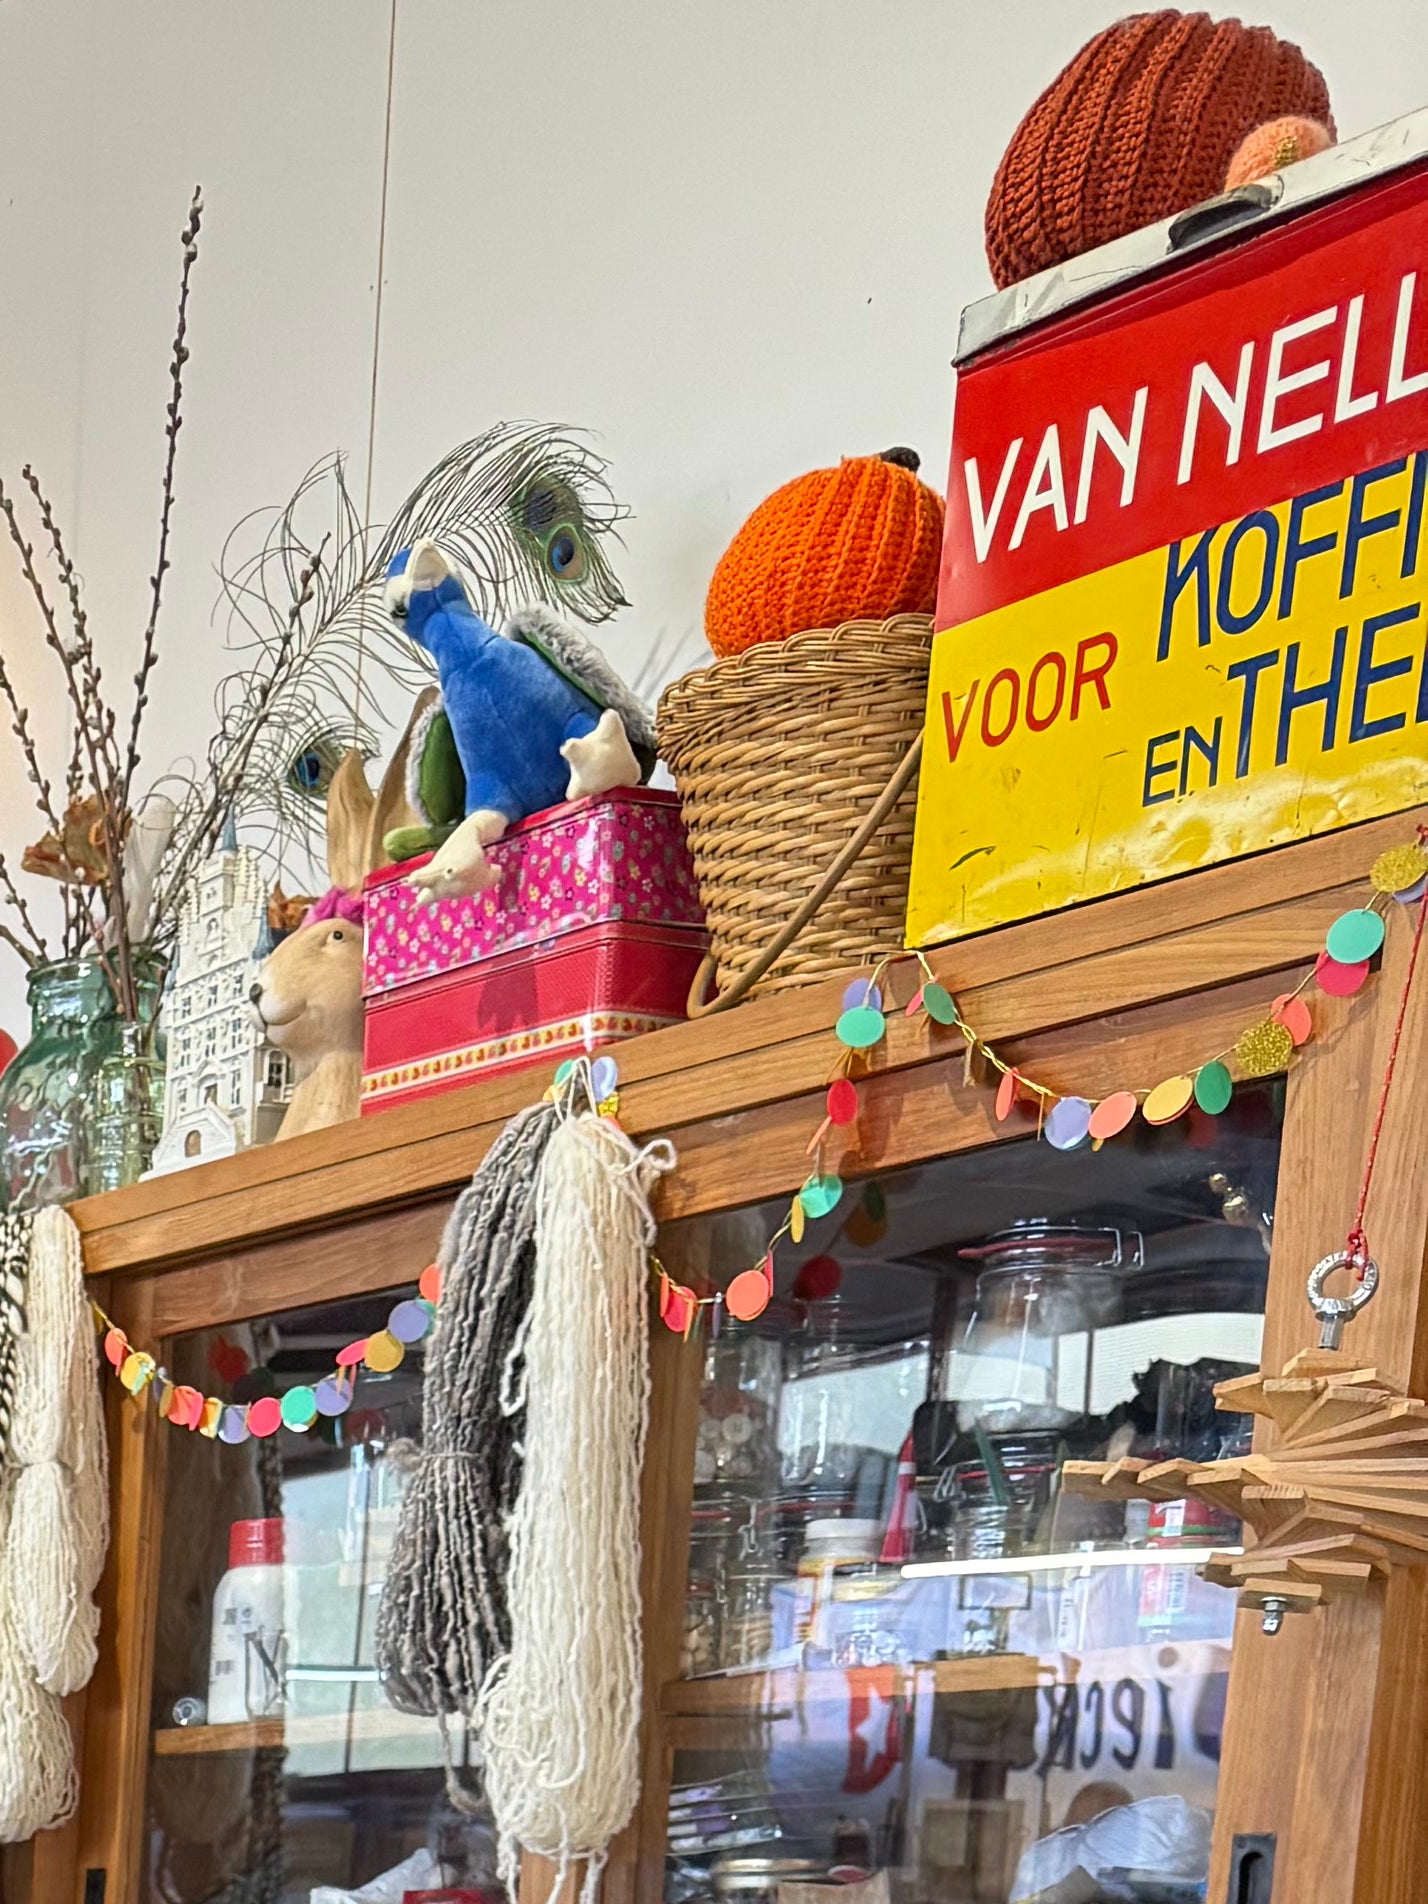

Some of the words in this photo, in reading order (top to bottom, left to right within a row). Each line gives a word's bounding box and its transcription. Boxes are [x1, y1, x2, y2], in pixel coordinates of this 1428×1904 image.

[963, 385, 1151, 564] VAN
[1177, 270, 1428, 485] NELL
[941, 631, 1121, 764] VOOR
[1142, 714, 1222, 809] EN
